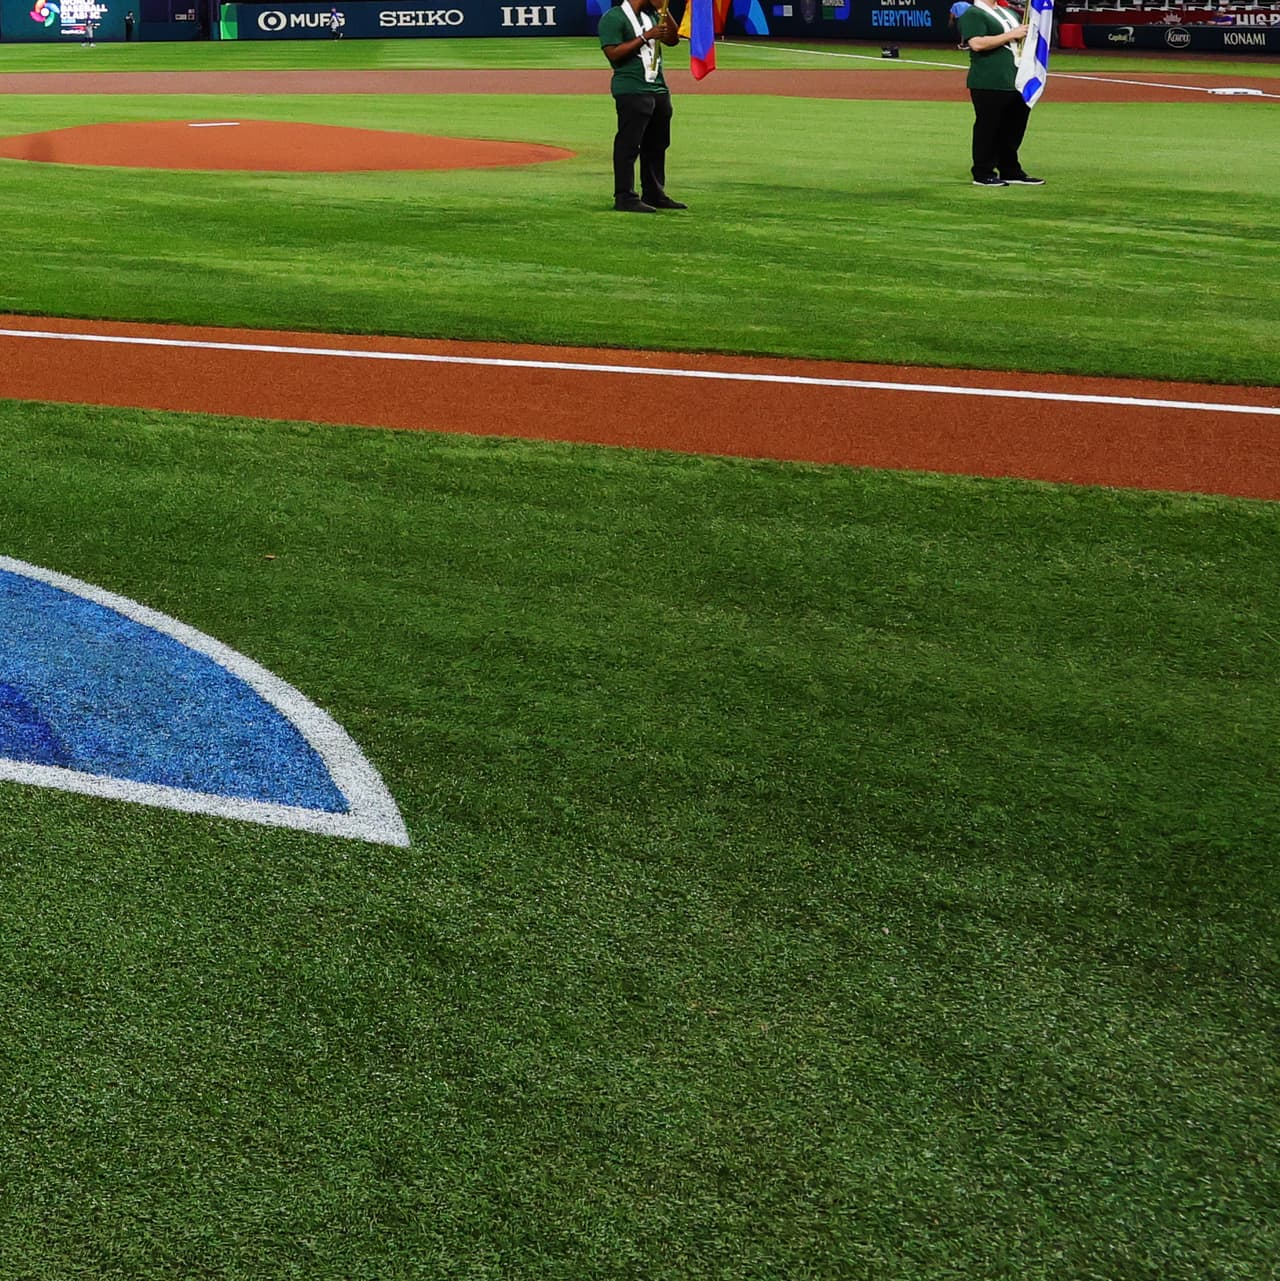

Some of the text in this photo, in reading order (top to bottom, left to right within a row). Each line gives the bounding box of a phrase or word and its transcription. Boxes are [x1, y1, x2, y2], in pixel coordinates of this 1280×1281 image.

[379, 9, 464, 27] SEIKO
[501, 6, 556, 26] IHI
[871, 10, 932, 27] EVERYTHING
[1223, 32, 1266, 46] KONAMI
